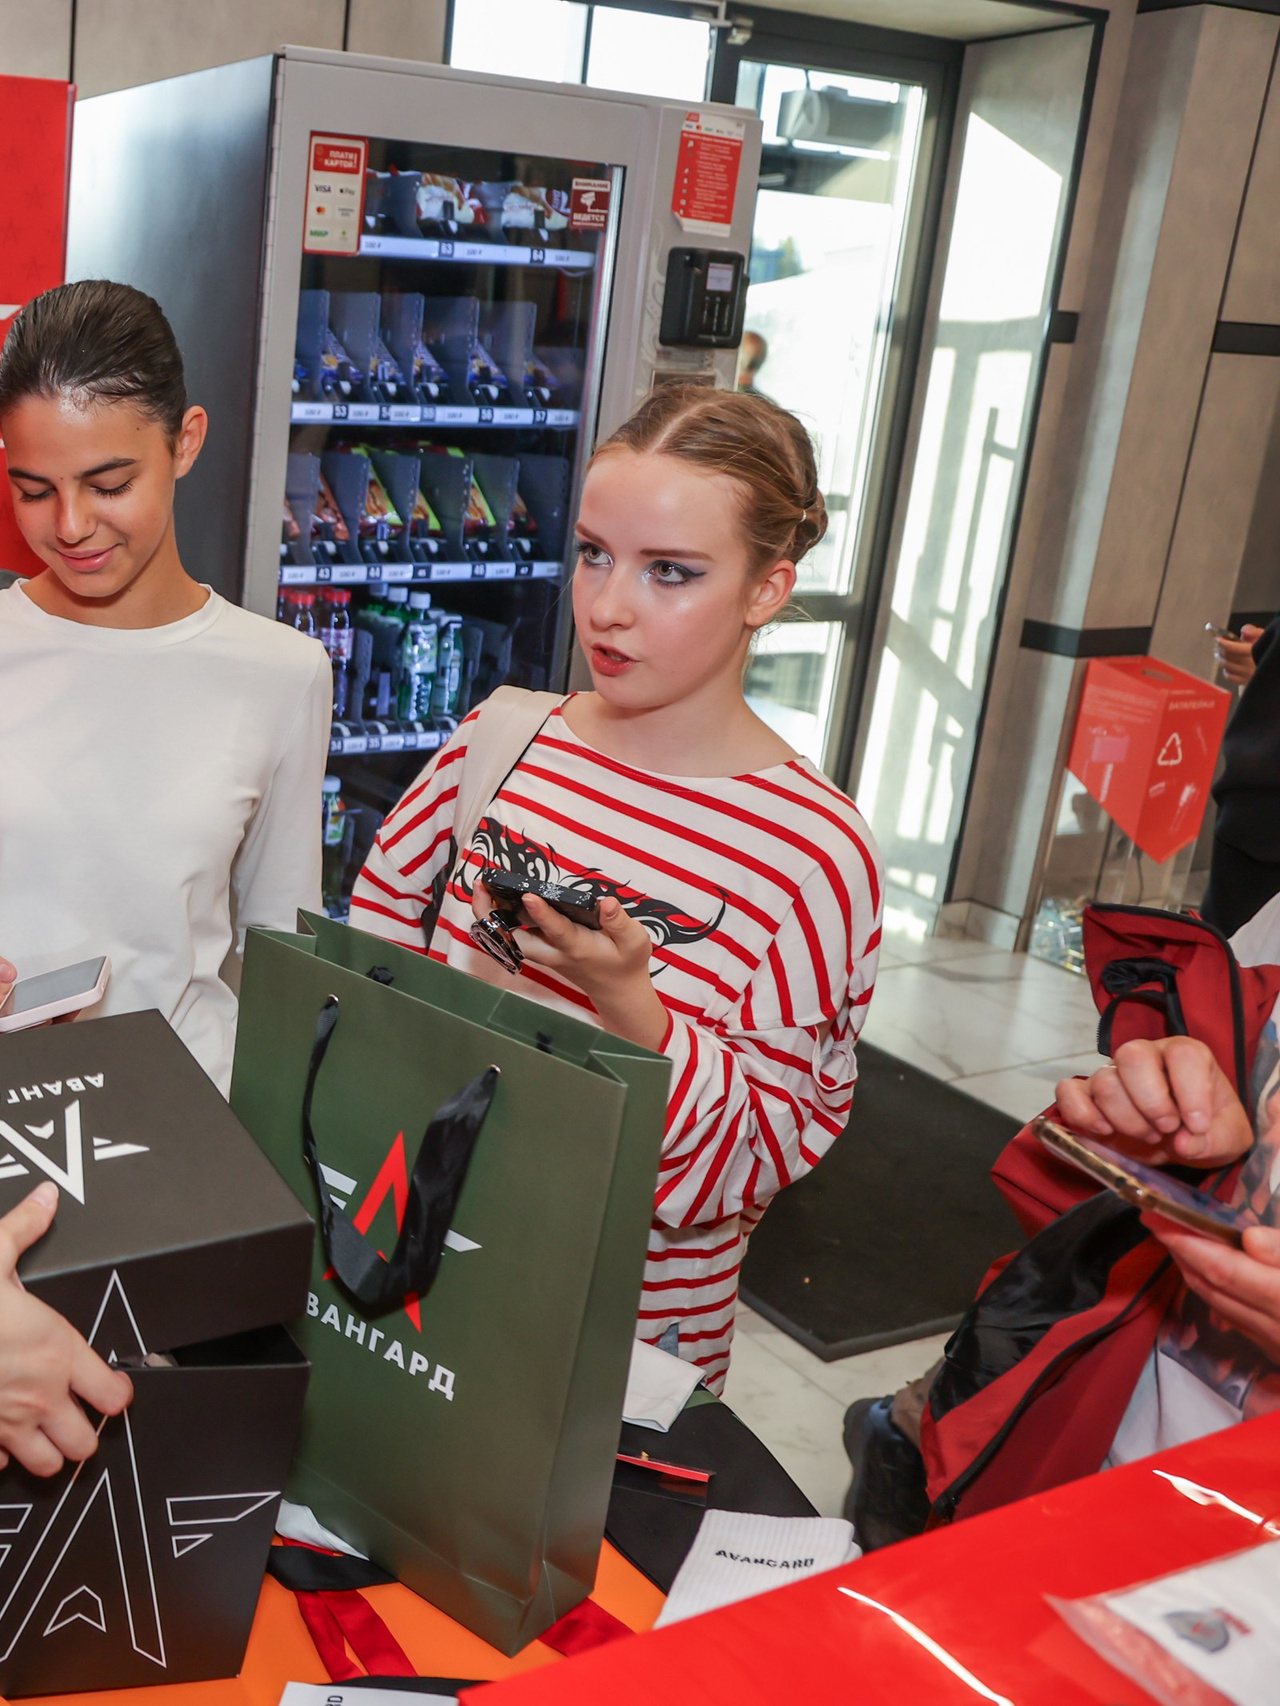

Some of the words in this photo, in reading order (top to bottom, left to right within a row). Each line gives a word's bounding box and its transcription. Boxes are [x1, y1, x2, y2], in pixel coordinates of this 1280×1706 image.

[318, 567, 331, 579] 43
[369, 566, 380, 578] 44
[715, 1549, 815, 1569] AVANGARD
